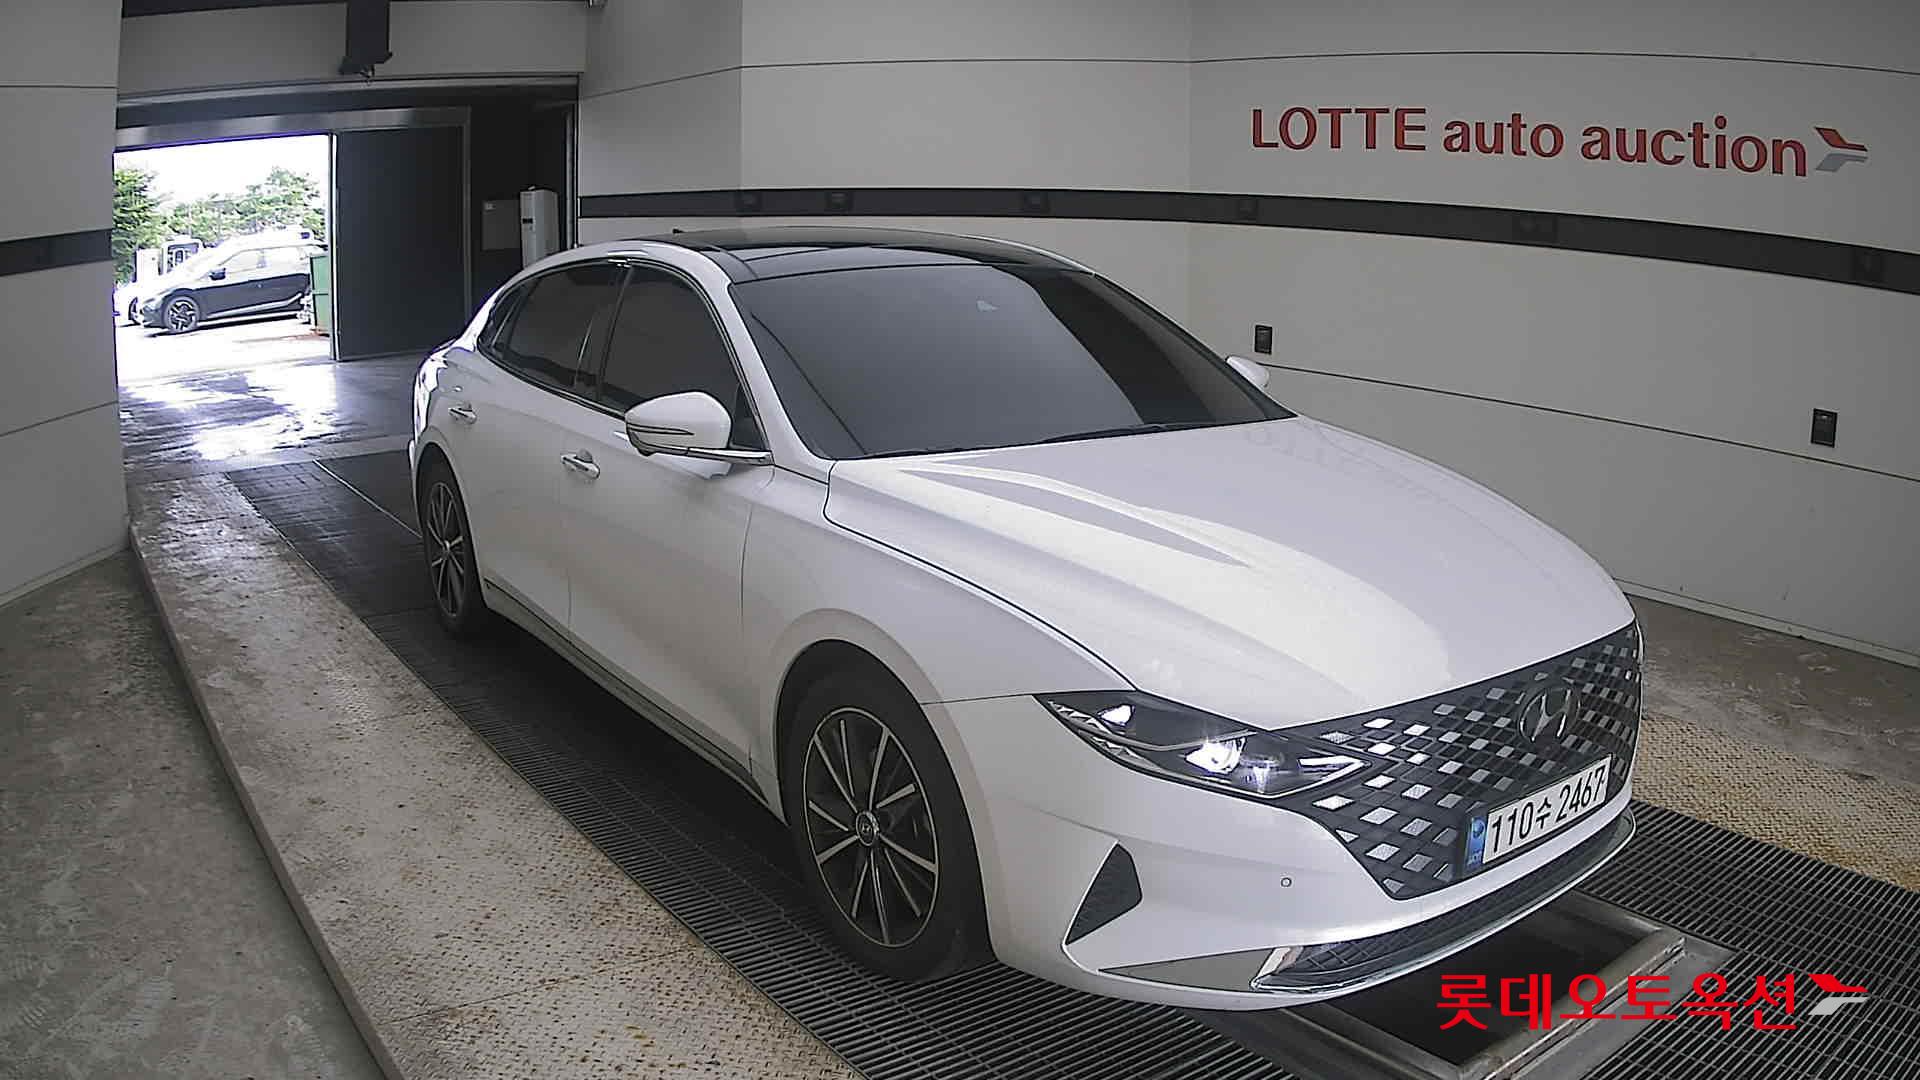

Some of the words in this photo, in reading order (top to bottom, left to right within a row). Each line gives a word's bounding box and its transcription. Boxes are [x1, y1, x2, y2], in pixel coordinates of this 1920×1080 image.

[1252, 106, 1427, 151] LOTTE
[1443, 113, 1565, 158] auto
[1580, 115, 1808, 178] auction
[1491, 796, 1552, 853] 110수
[1555, 764, 1606, 823] 2467
